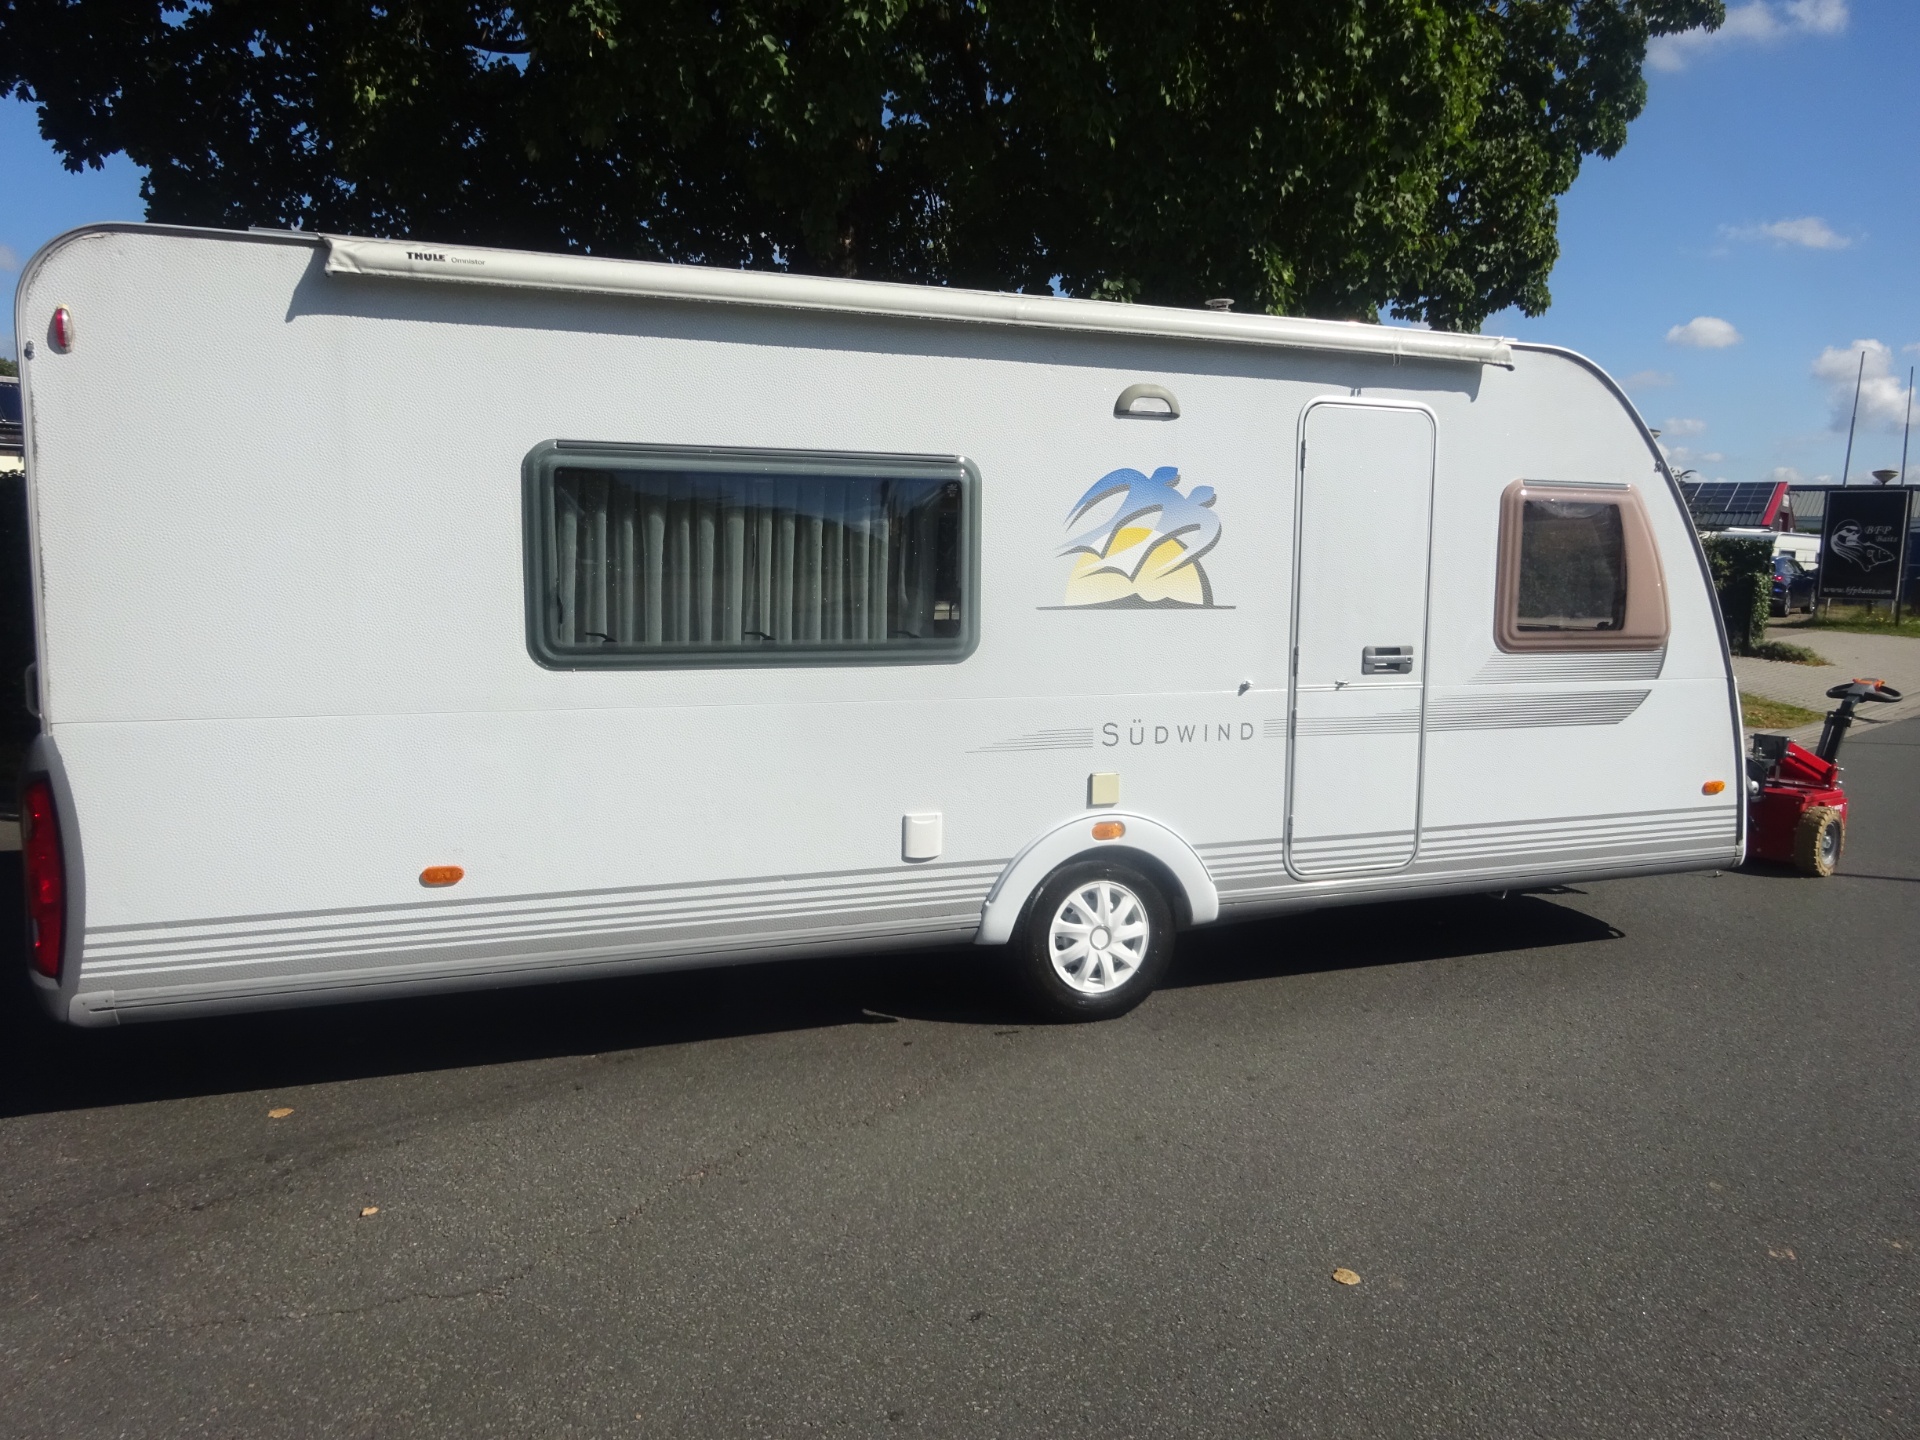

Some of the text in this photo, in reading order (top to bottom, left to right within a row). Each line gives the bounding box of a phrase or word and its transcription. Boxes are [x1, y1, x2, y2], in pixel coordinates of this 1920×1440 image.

[406, 252, 485, 265] THULE Omnistor
[1101, 718, 1254, 747] SÜDWIND
